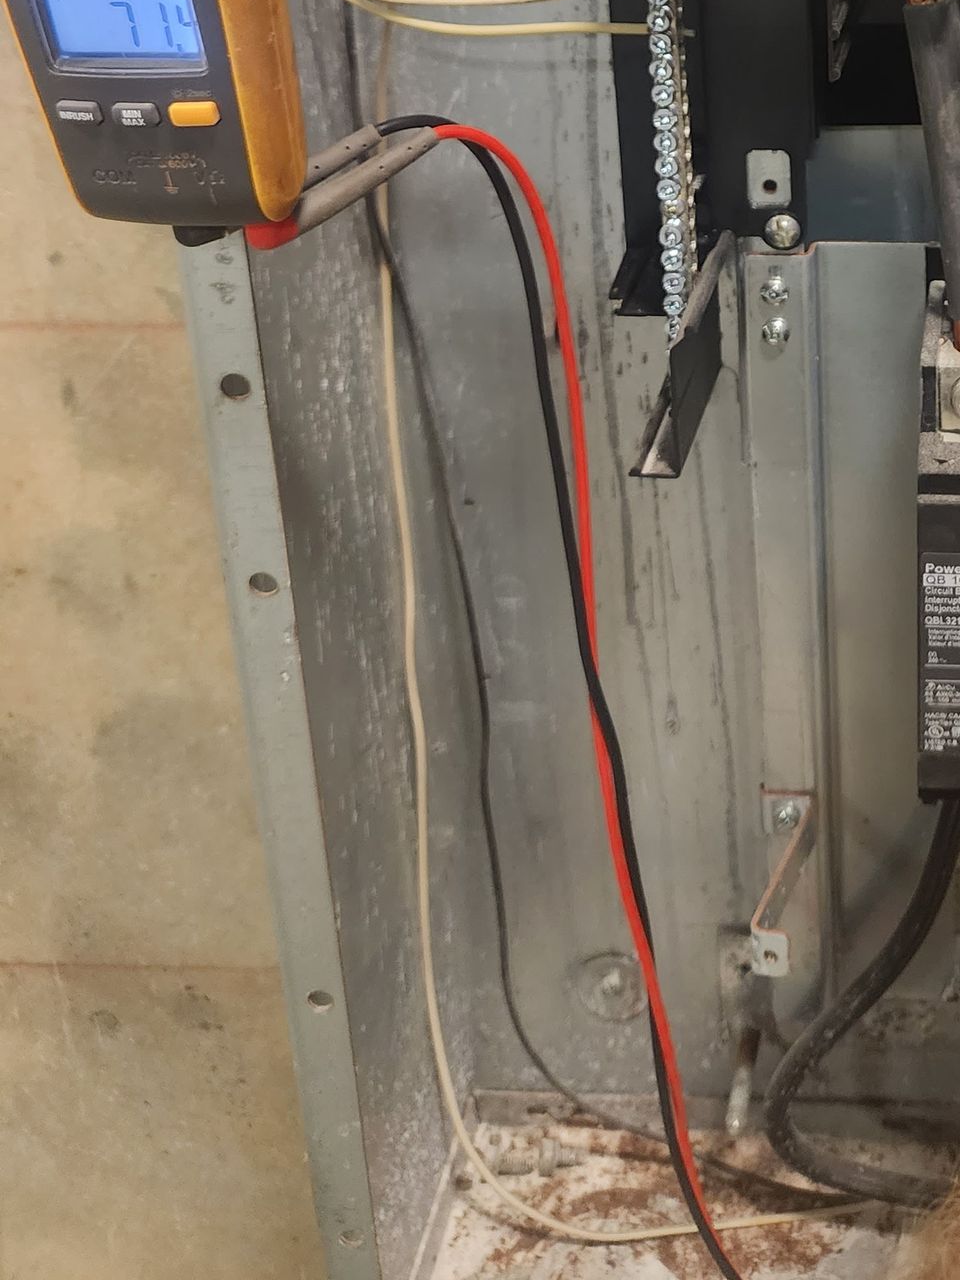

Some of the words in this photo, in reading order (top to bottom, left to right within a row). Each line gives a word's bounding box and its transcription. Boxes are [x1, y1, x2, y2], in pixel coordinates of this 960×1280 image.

[59, 111, 94, 121] INRUSH
[121, 109, 142, 119] MIN
[121, 118, 146, 126] MAX
[926, 575, 946, 585] QB
[924, 586, 953, 595] Circuit
